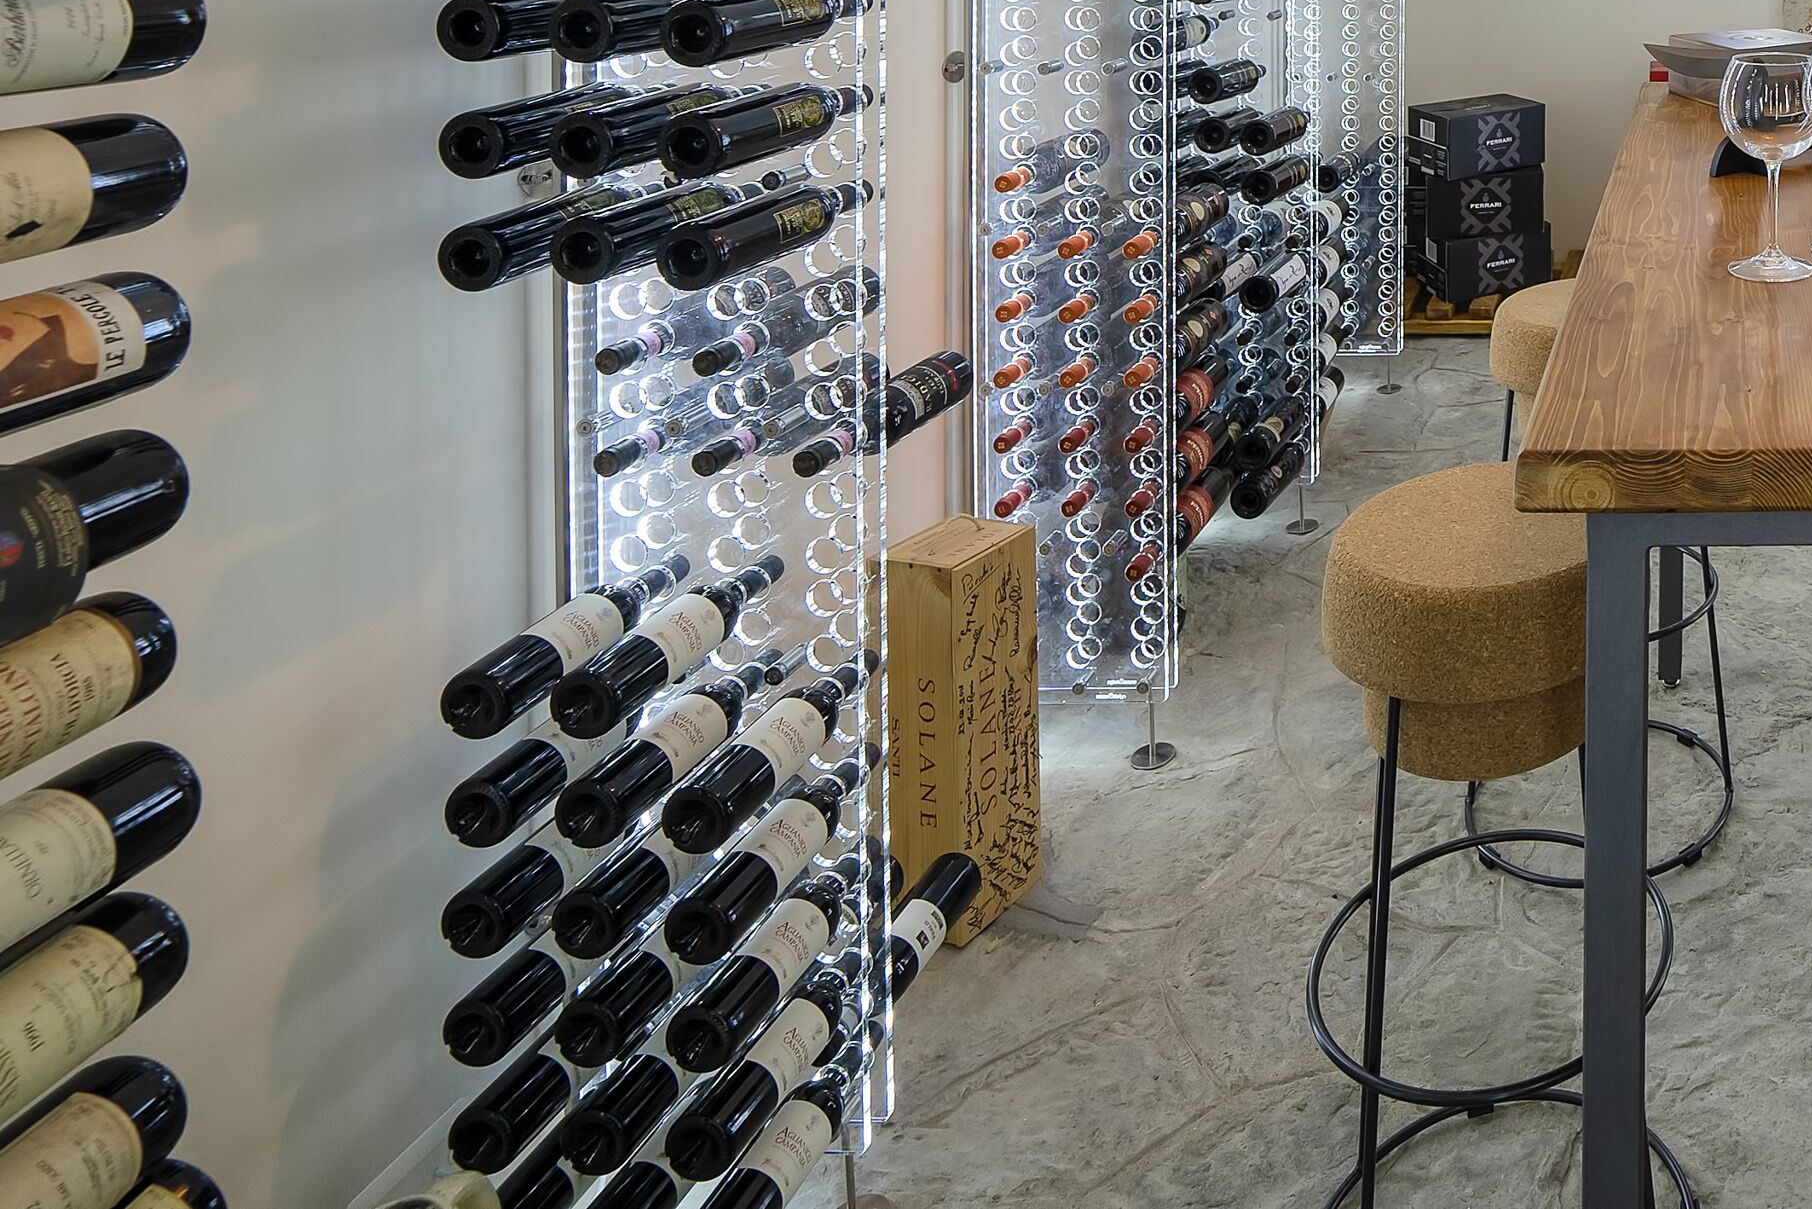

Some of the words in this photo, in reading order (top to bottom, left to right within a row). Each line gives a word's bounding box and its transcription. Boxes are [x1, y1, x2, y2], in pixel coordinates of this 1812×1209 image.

[1486, 136, 1513, 146] FERRARI
[1486, 258, 1516, 268] FERRARI
[85, 292, 123, 349] PERGOLE
[106, 349, 126, 372] LE
[891, 717, 900, 777] SANTI
[917, 678, 937, 829] SOLANE
[979, 665, 998, 816] SOLANE
